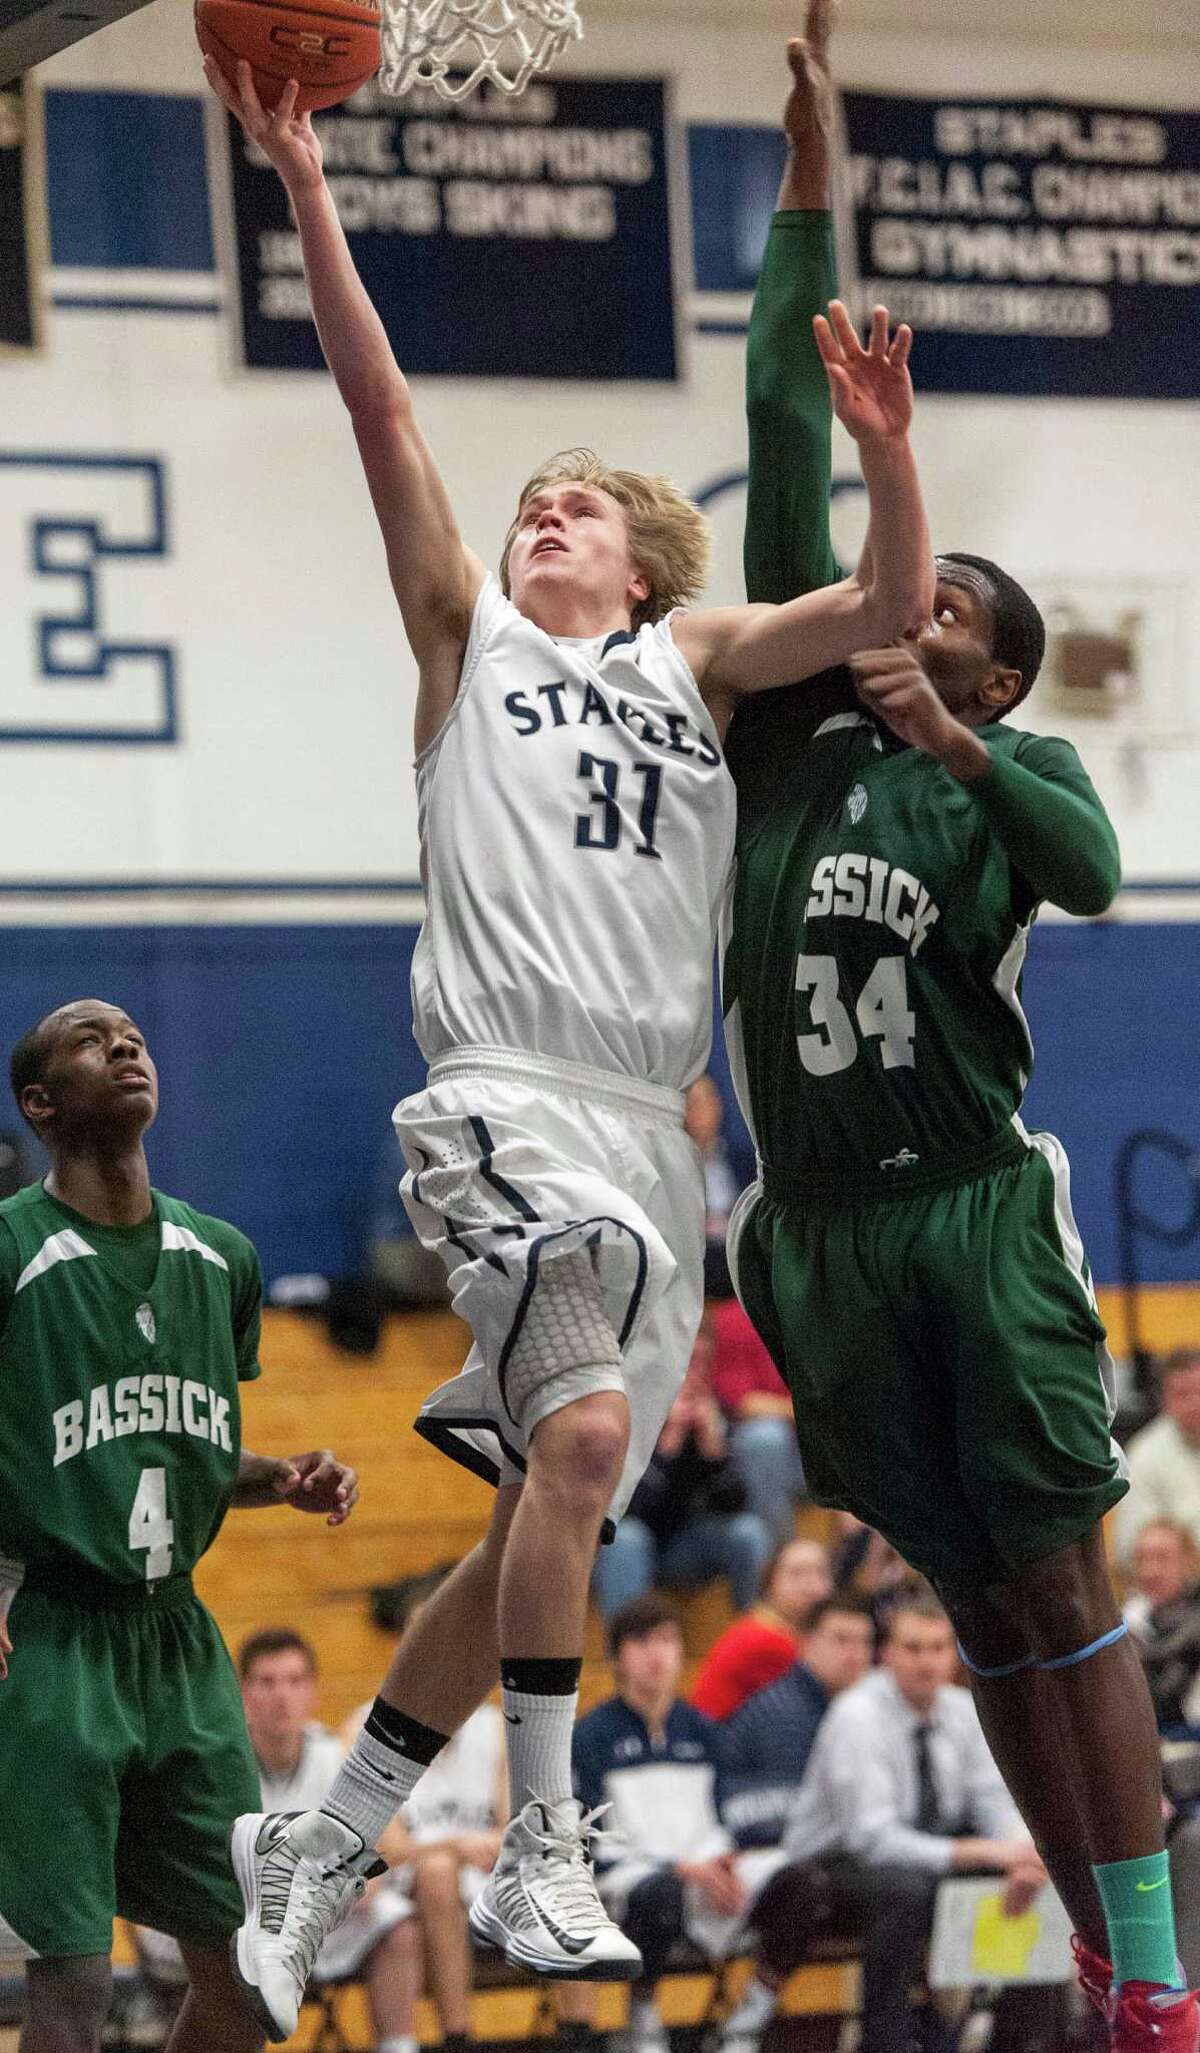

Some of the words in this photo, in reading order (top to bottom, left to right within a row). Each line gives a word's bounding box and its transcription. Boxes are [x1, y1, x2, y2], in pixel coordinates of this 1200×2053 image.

[574, 750, 664, 860] 31
[804, 853, 940, 958] SSICK
[795, 953, 916, 1077] 34
[52, 1374, 233, 1468] BASSICK
[129, 1467, 174, 1580] 4
